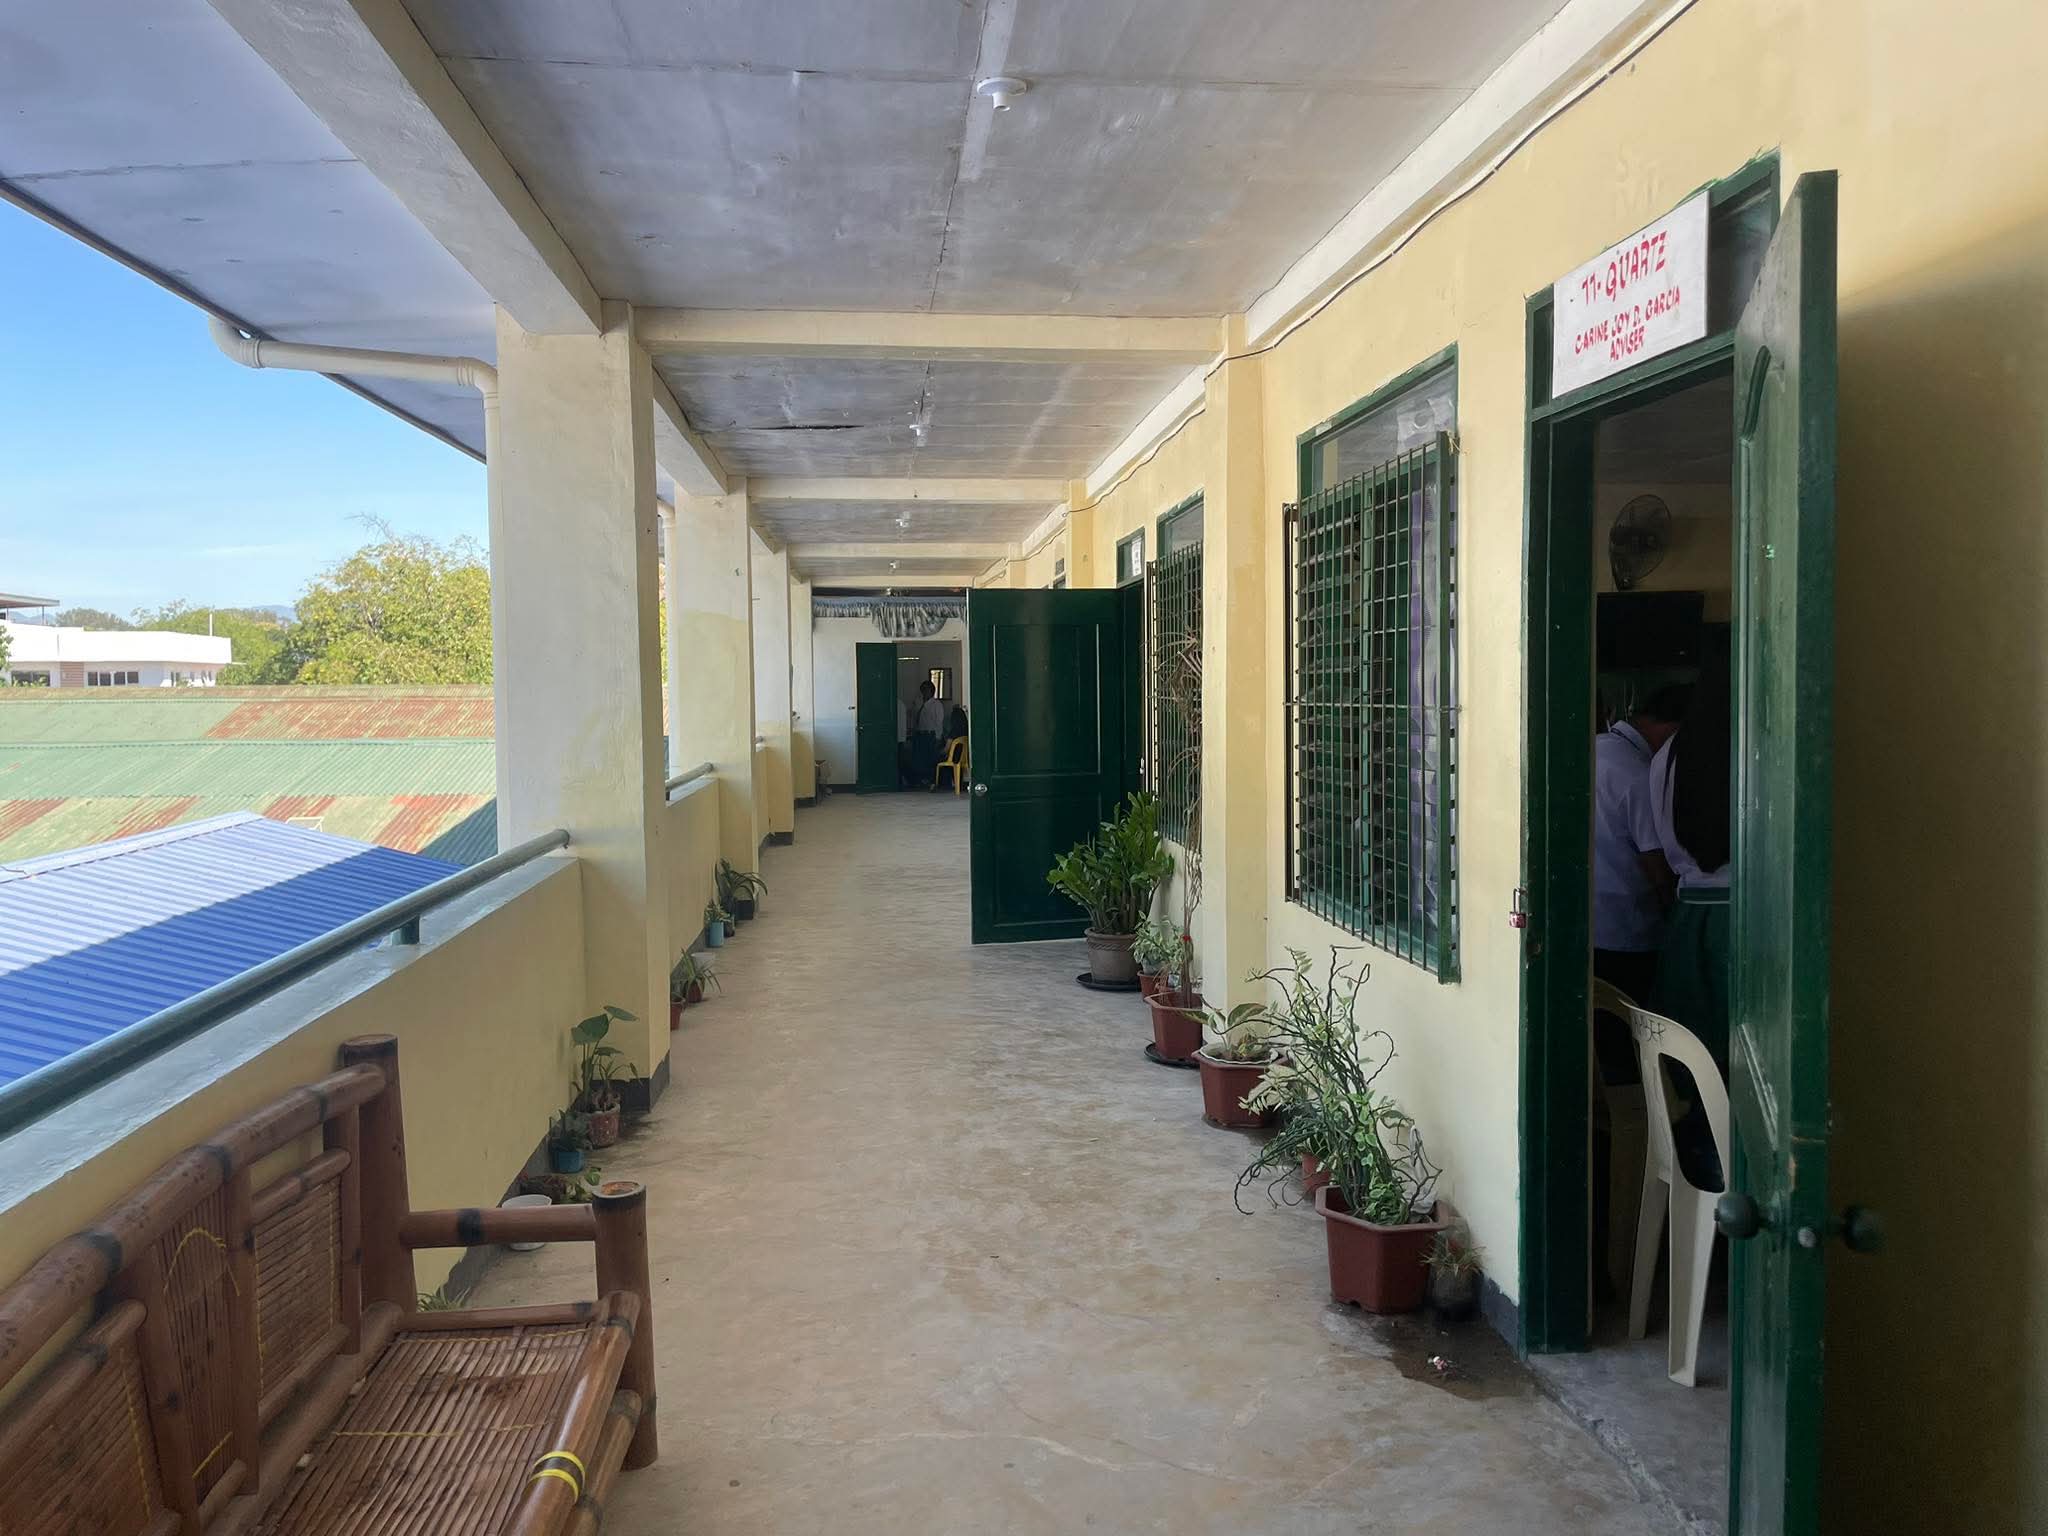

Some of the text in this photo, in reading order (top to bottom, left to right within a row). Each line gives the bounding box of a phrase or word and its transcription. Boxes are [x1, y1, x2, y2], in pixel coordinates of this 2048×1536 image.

[1574, 320, 1609, 354] CARINE
[1611, 310, 1631, 337] JOY
[1645, 286, 1681, 321] GARCIA
[1609, 325, 1645, 362] ADVISER
